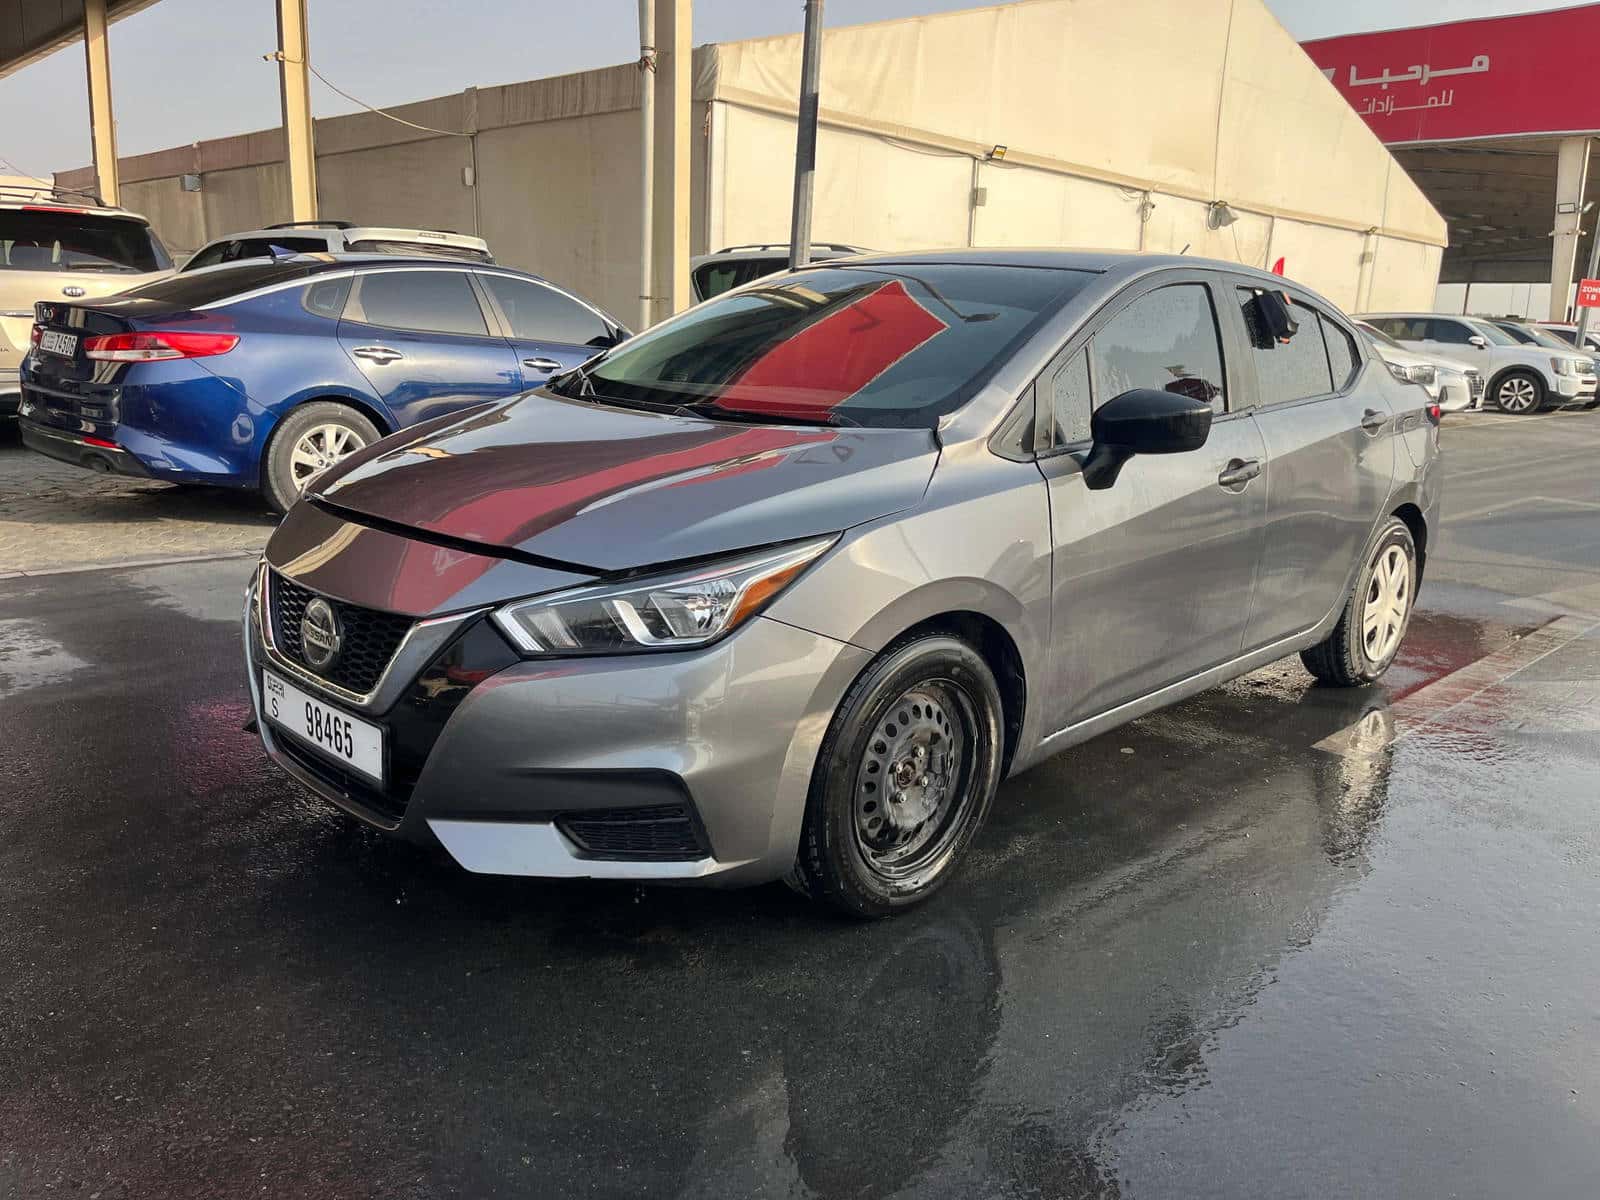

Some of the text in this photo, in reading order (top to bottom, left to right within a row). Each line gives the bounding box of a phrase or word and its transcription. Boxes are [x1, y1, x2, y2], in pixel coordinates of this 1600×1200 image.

[1349, 55, 1489, 90] مرحبا
[271, 697, 279, 718] S
[305, 701, 353, 759] 98465
